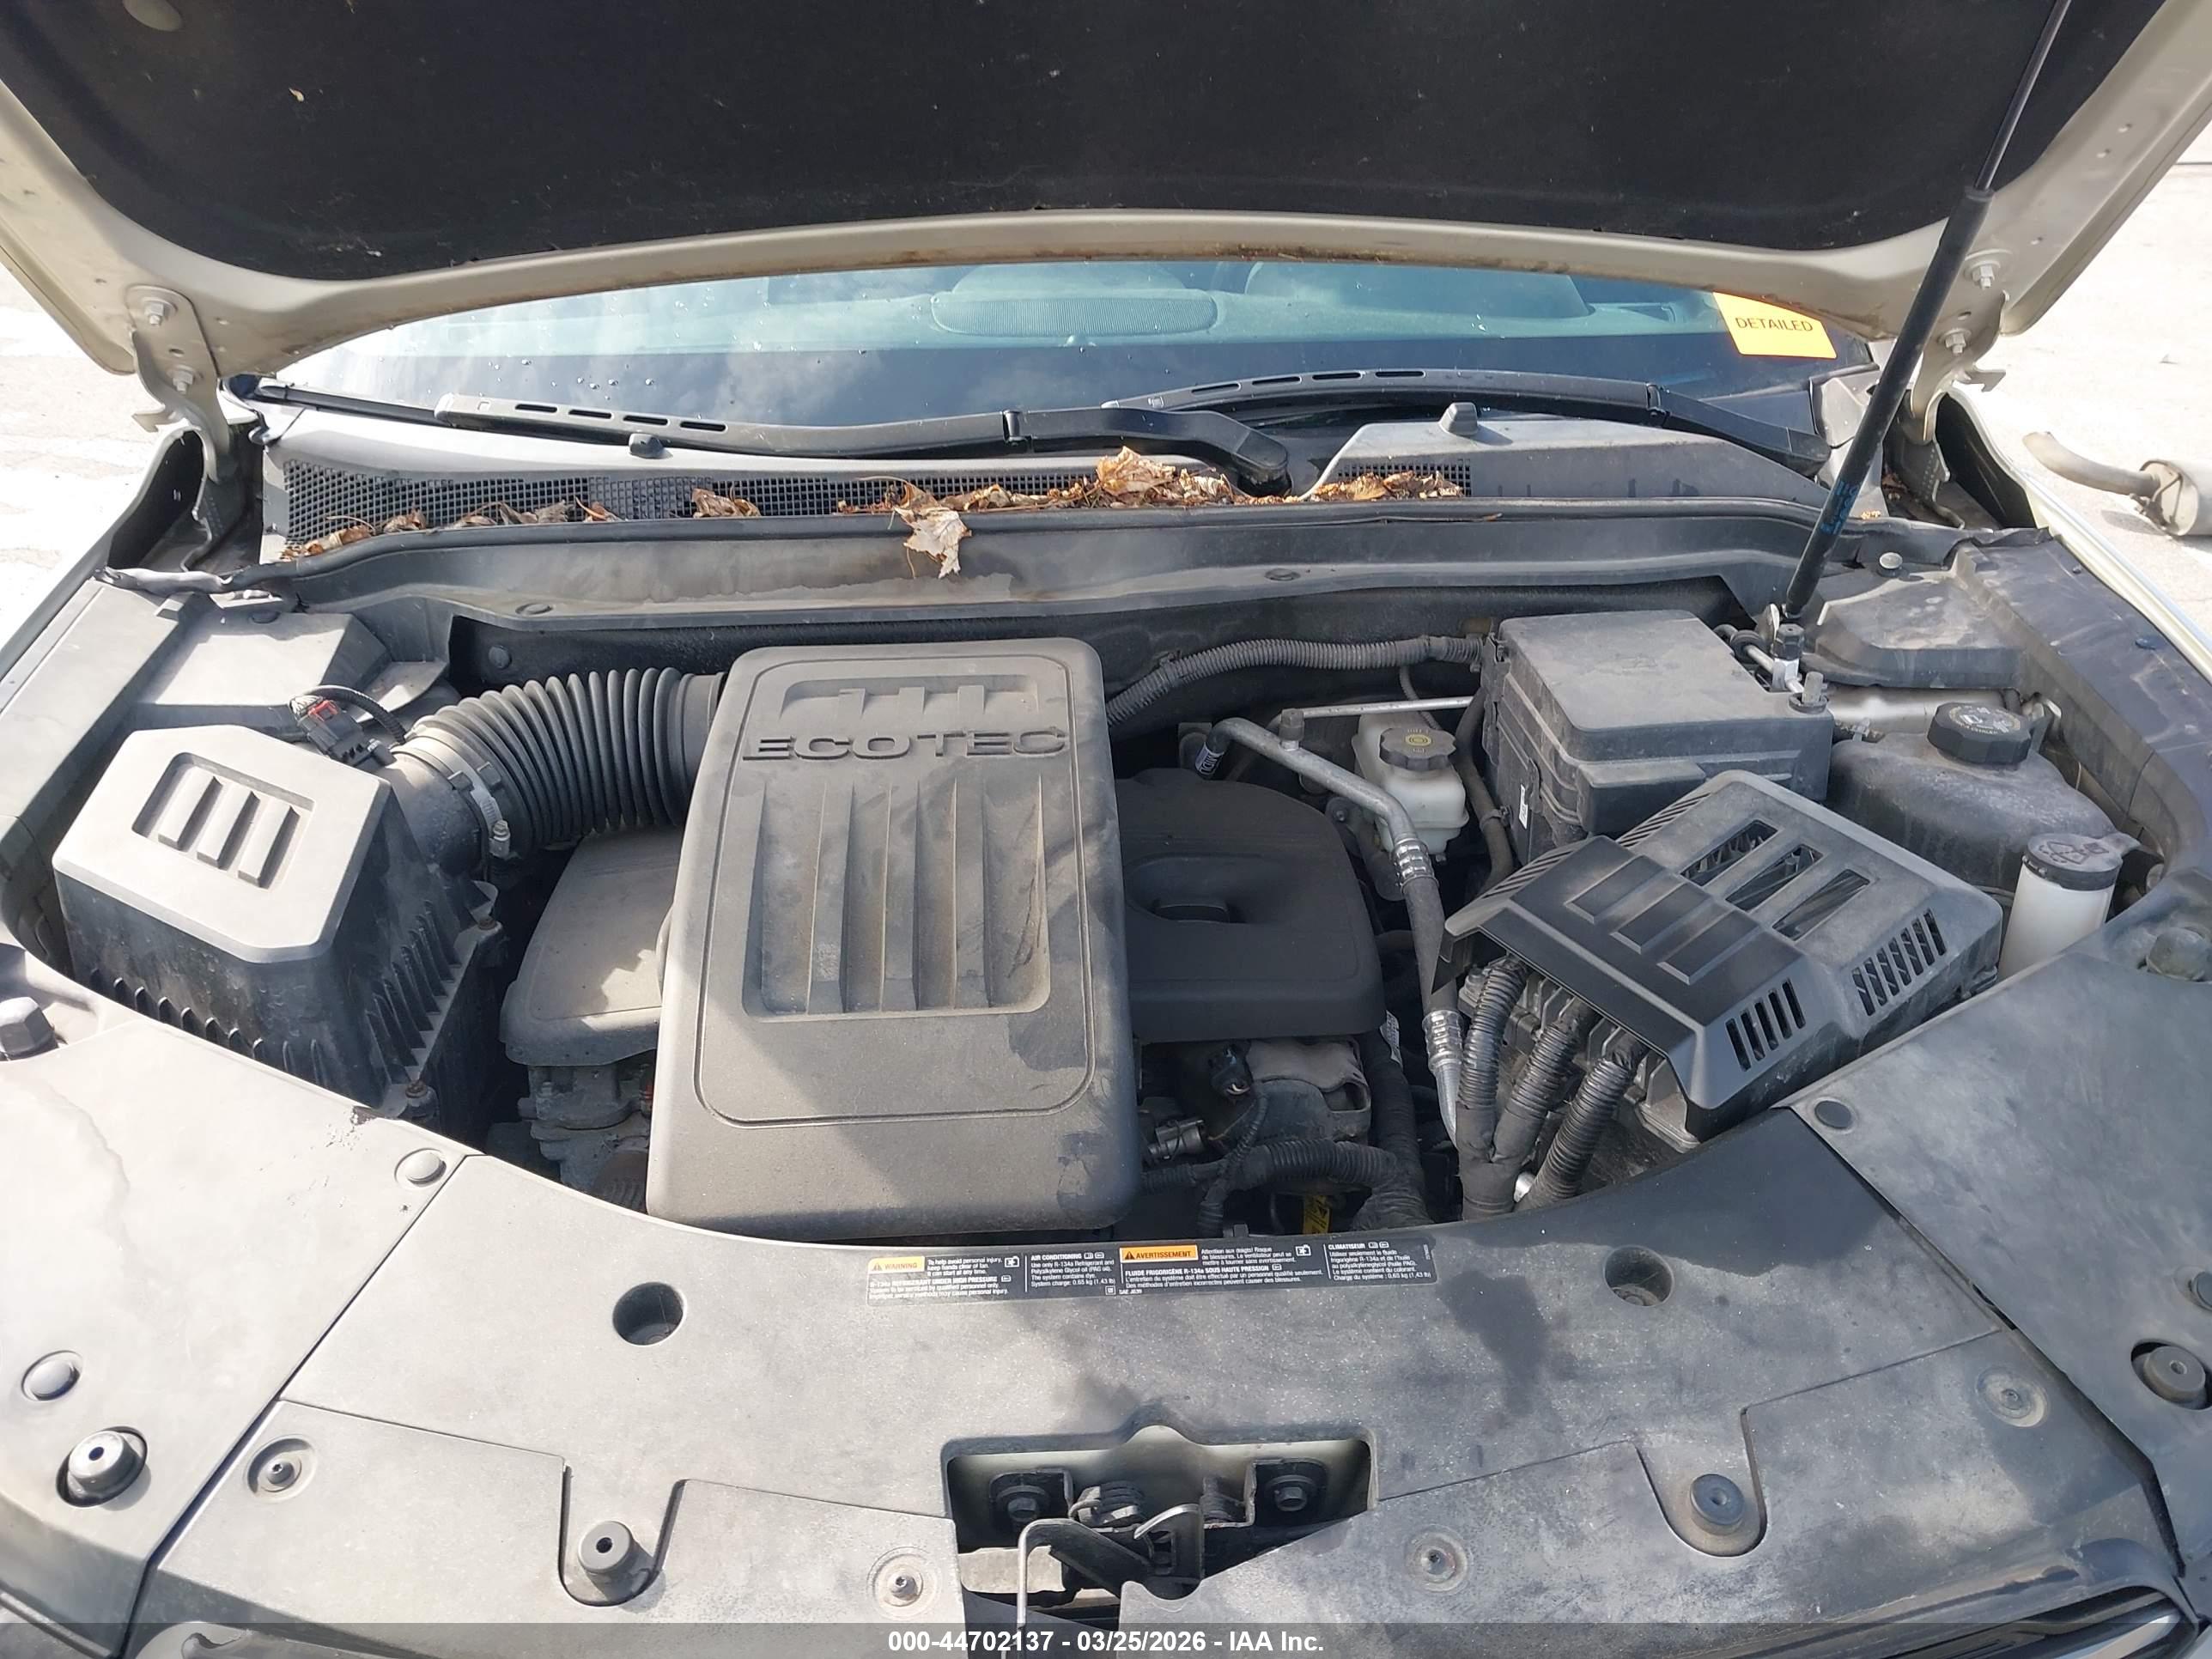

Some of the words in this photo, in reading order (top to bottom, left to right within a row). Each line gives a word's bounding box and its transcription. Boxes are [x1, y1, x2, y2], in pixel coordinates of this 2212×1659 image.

[1735, 317, 1813, 331] DETAILED
[743, 726, 1070, 762] ECOTEC
[1135, 1250, 1191, 1259] AVERTISSEMENT
